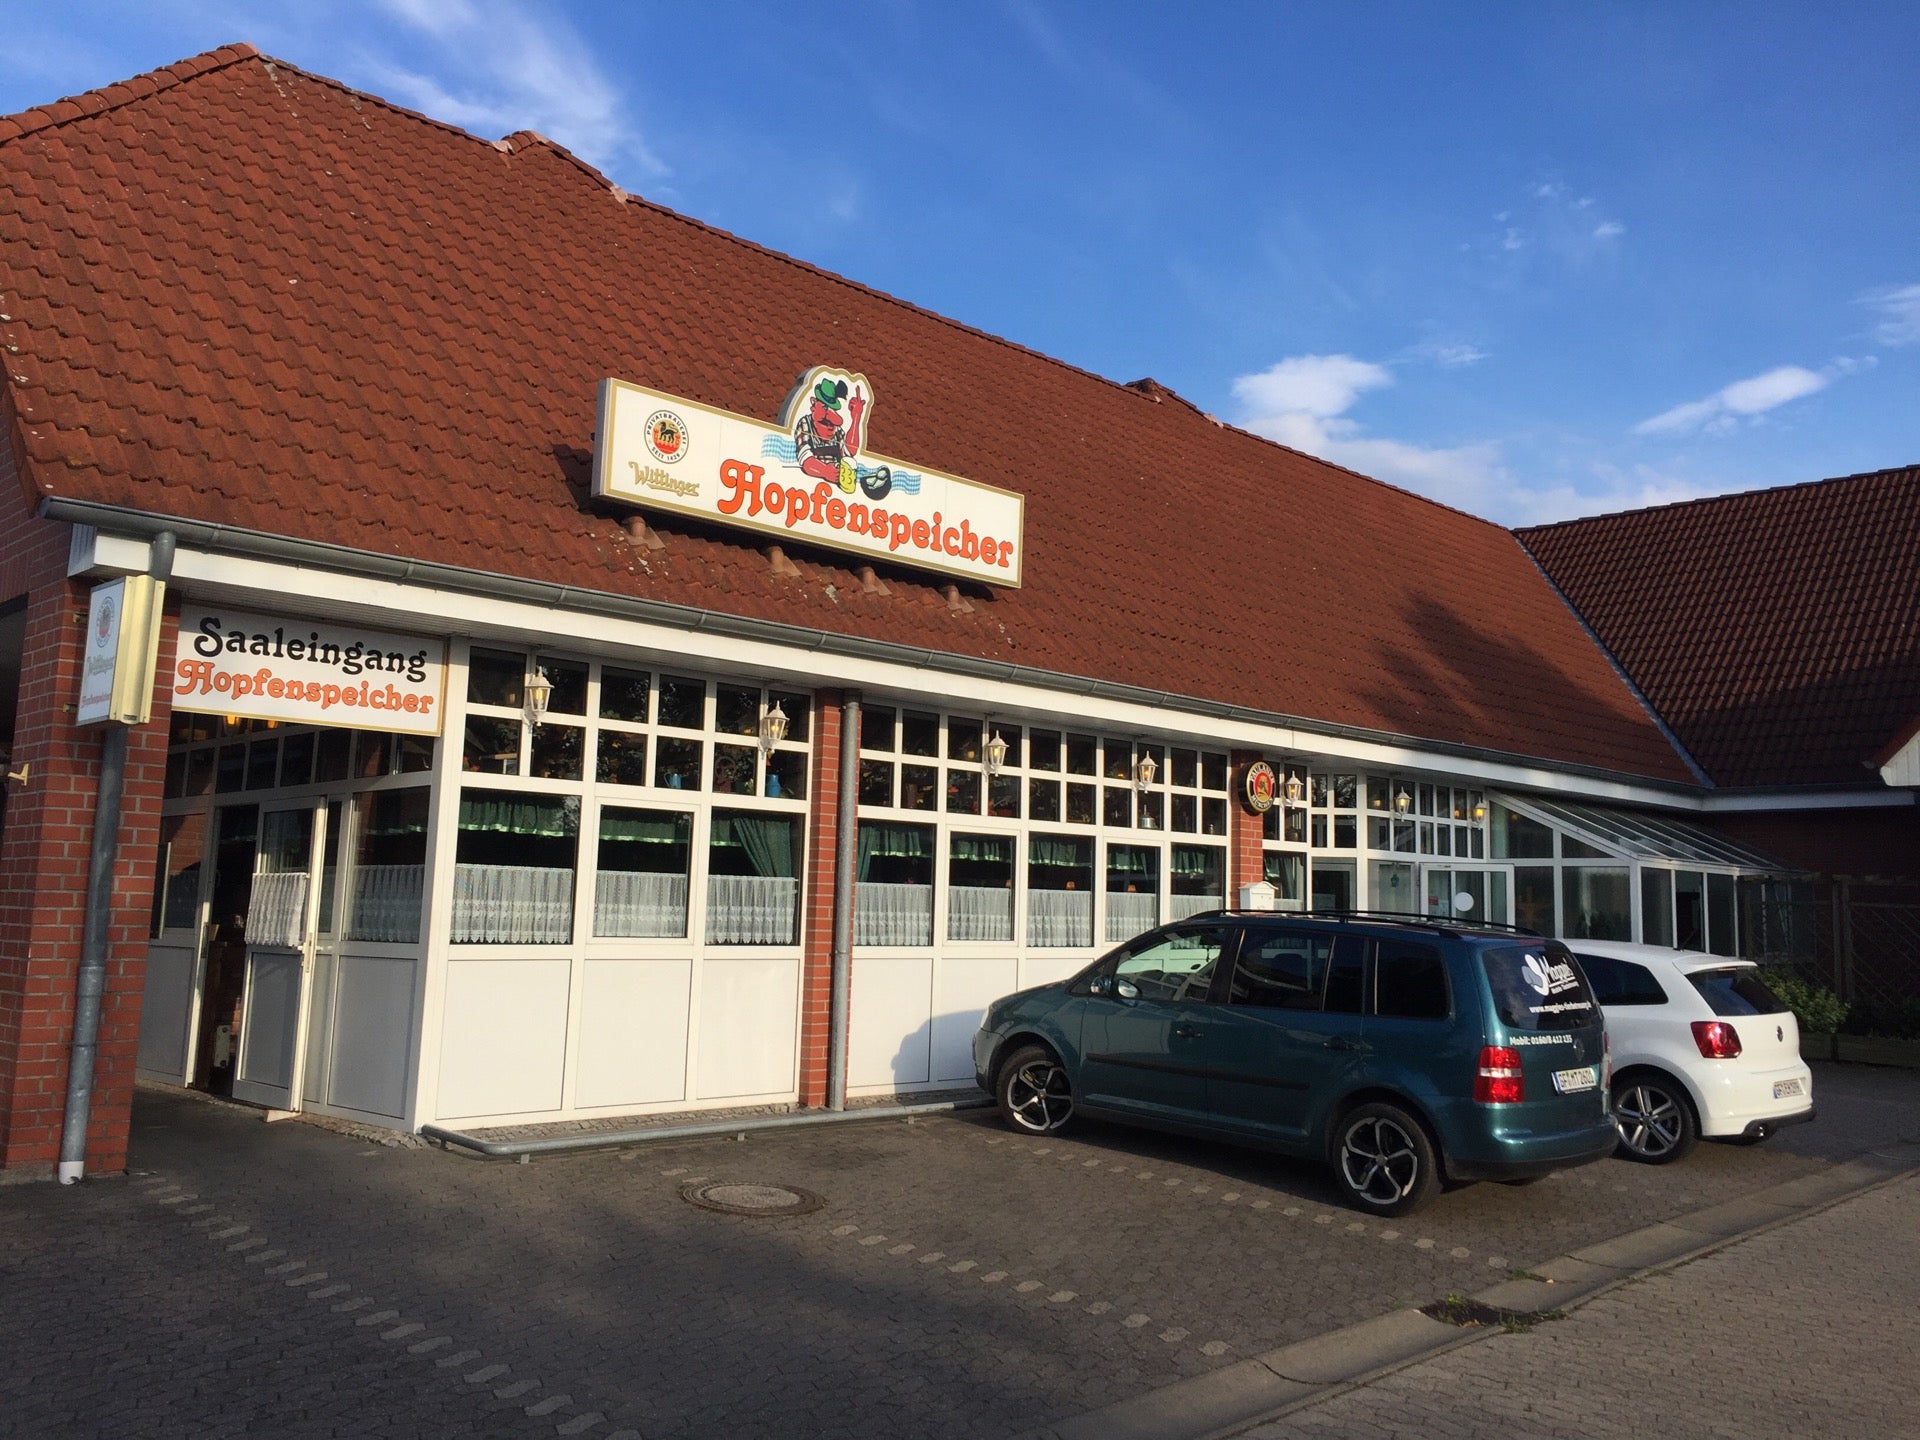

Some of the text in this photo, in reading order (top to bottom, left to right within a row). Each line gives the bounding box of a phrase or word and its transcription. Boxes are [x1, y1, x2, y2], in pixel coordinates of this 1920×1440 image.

[646, 413, 687, 445] PRIVATBRAUEREI
[628, 461, 700, 497] Wittinger
[717, 458, 1014, 569] Hopfenspeicher
[194, 616, 427, 683] Saaleingang
[174, 658, 434, 714] Hopfenspeicher
[1509, 1035, 1530, 1046] Mobil:
